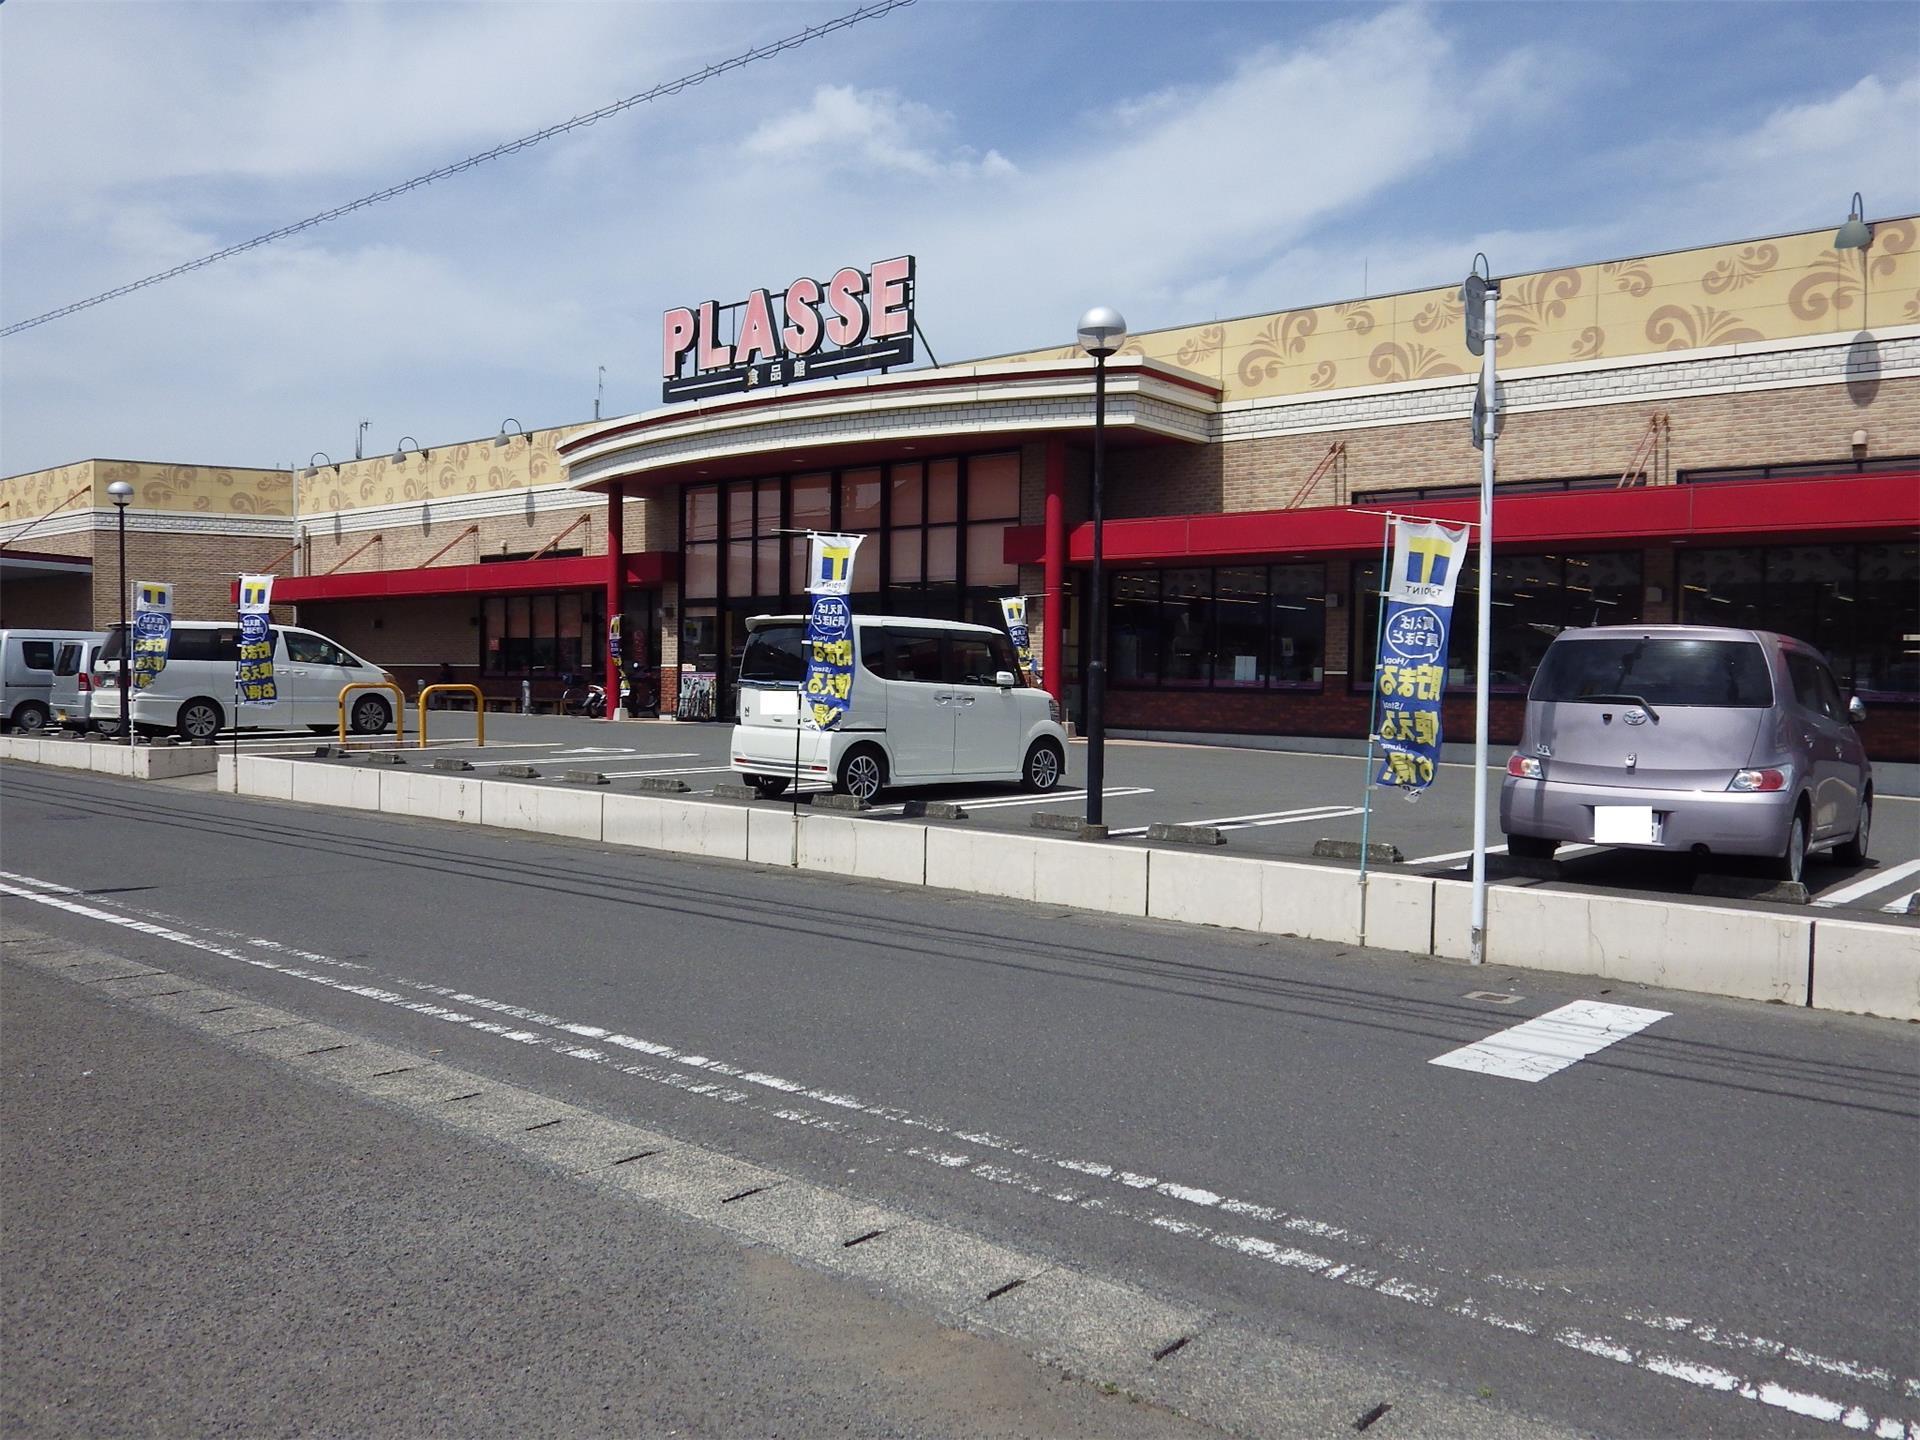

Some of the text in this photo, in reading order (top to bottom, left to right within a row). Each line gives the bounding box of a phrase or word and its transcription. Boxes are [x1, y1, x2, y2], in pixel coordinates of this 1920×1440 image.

[663, 255, 914, 379] PLASSE
[747, 360, 807, 386] 食品館
